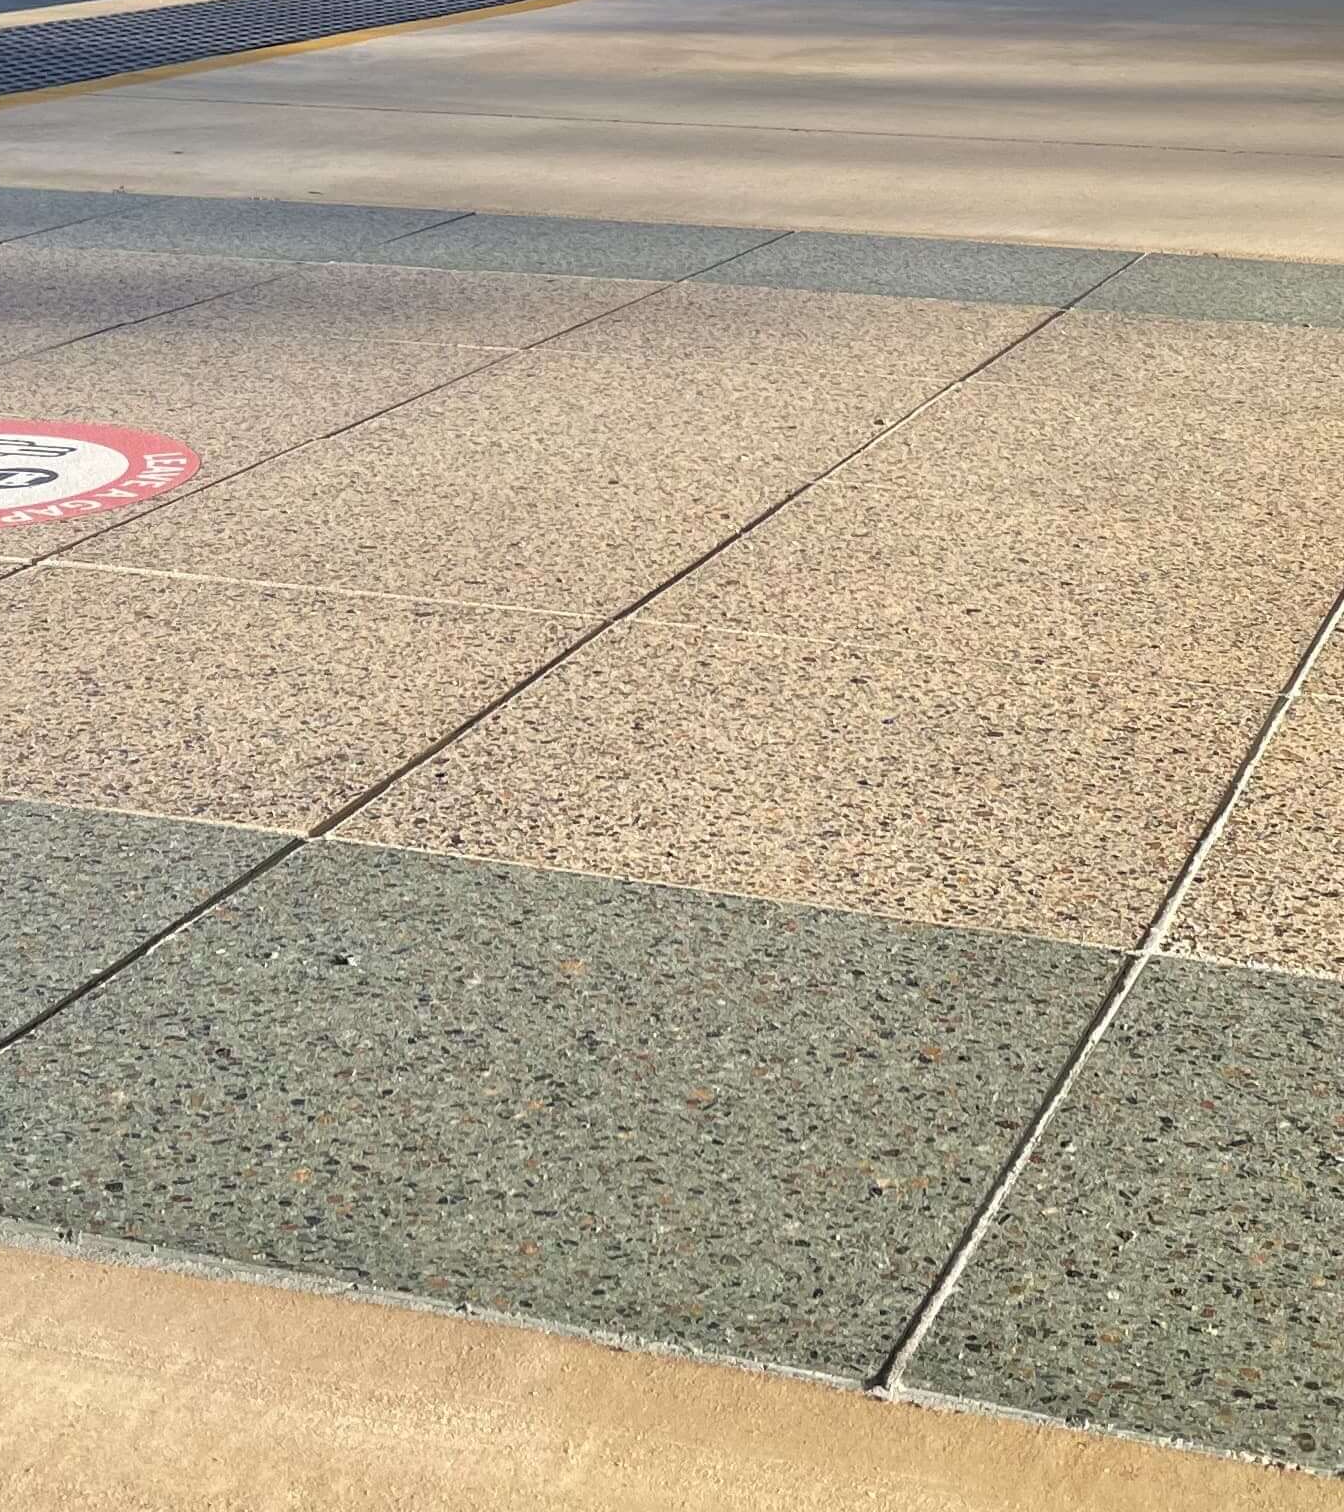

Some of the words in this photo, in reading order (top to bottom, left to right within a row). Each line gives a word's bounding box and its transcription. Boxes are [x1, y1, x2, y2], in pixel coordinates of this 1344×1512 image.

[122, 452, 187, 488] LEAVE
[95, 488, 139, 498] A
[0, 499, 102, 523] GAP
